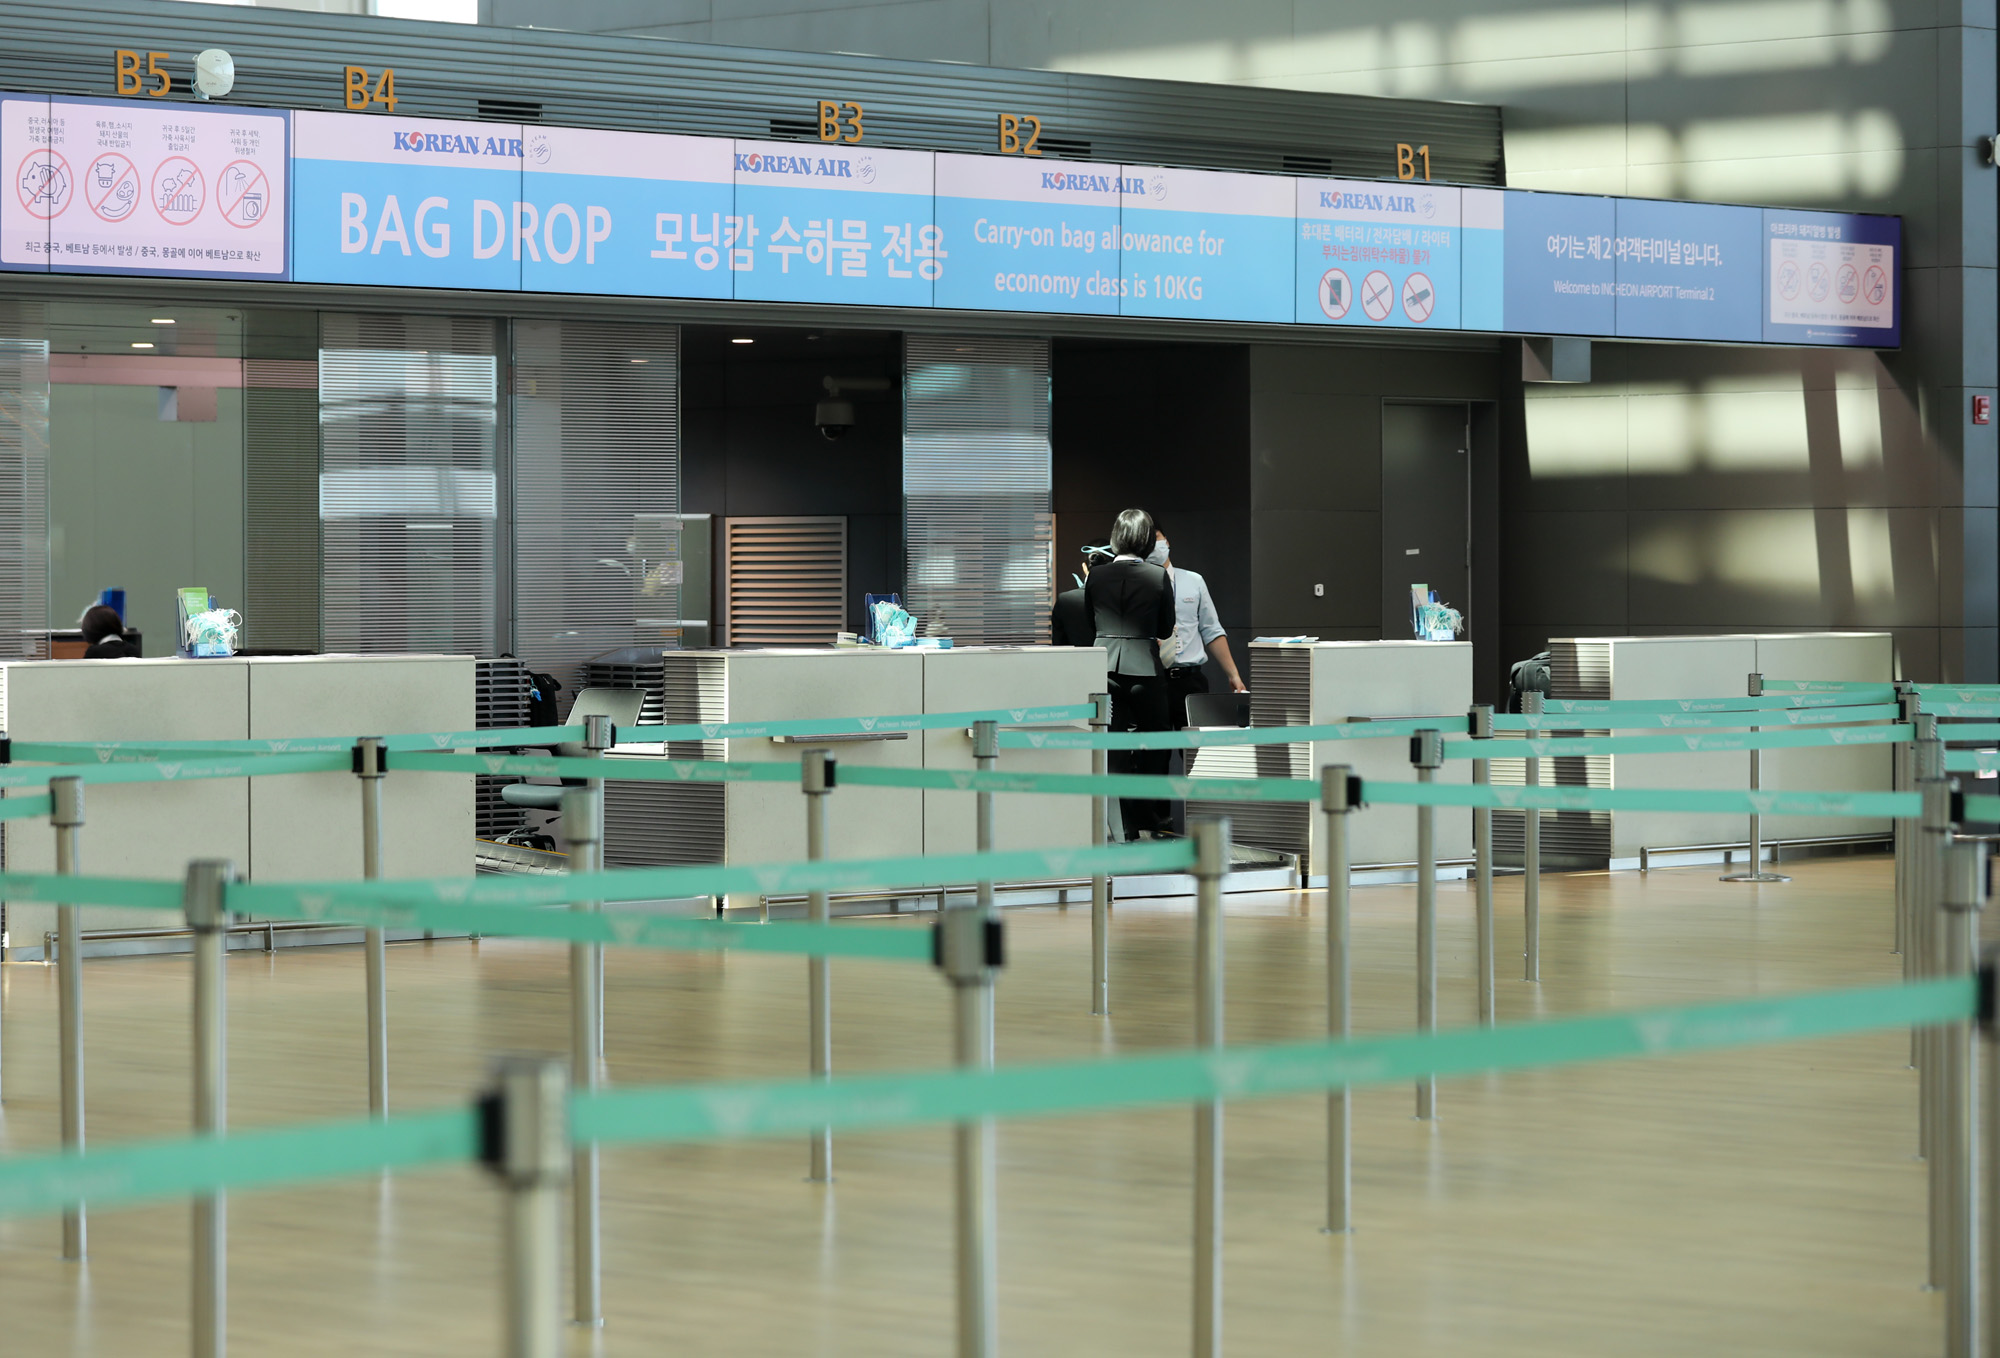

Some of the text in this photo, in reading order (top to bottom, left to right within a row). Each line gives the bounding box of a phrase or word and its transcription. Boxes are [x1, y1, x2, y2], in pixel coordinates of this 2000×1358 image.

[114, 50, 171, 97] B5
[344, 66, 398, 112] B4
[162, 124, 173, 132] 귀국
[181, 126, 195, 134] 5일간
[230, 129, 240, 137] 귀국
[241, 129, 247, 137] 후
[817, 101, 863, 143] B3
[998, 113, 1042, 155] B2
[97, 138, 108, 147] 국내
[249, 139, 260, 147] 개인
[394, 132, 525, 158] KOREAN AIR
[734, 153, 852, 178] KOREAN AIR
[1396, 143, 1431, 182] B1
[1041, 172, 1110, 192] KOREAN
[1112, 176, 1146, 195] AIR
[1319, 191, 1384, 211] KOREAN
[1385, 195, 1416, 213] AIR
[340, 191, 612, 264] BAG DROP
[974, 218, 1225, 256] Carry-on bag allowance for
[1301, 223, 1332, 241] 휴대폰
[1335, 225, 1364, 243] 배터리
[1373, 227, 1412, 246] 전자담배
[1422, 230, 1450, 248] 라이터
[25, 242, 41, 253] 최근
[65, 243, 90, 254] 베트남
[92, 244, 115, 255] 등에서
[117, 245, 133, 256] 발생
[162, 247, 186, 259] 몽골에
[188, 248, 204, 259] 이어
[206, 249, 244, 260] 베트남으로
[246, 250, 261, 262] 확산
[650, 212, 949, 281] 모닝캄 수하물 전용
[1412, 249, 1431, 265] 불가
[1547, 234, 1585, 259] 여기는
[1587, 235, 1601, 260] 제
[1602, 237, 1612, 260] 2
[1613, 236, 1681, 265] 여객터미널
[994, 270, 1203, 301] economy class is 10KG
[1554, 280, 1715, 301] Welcome to INCHEON AIRPORT Terminal 2
